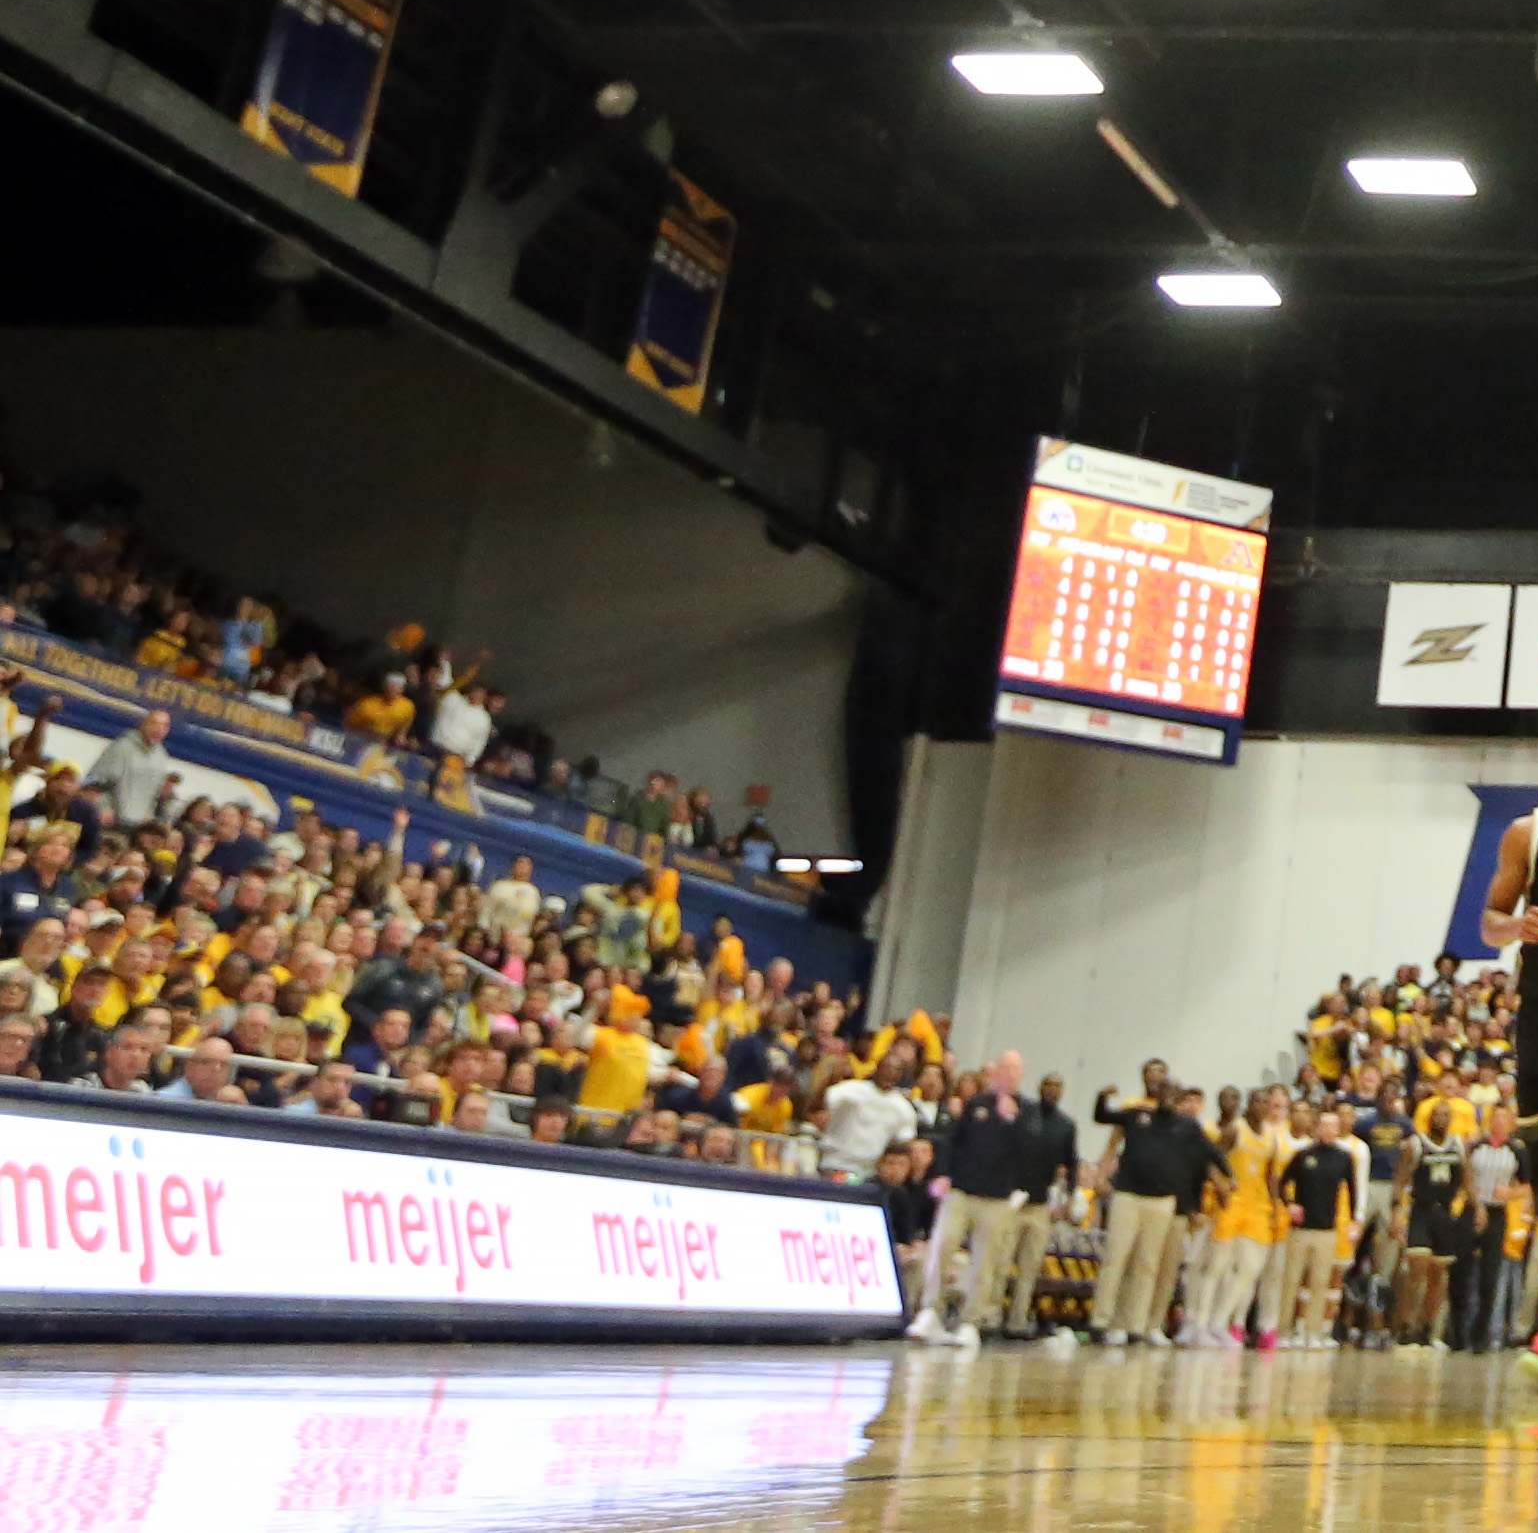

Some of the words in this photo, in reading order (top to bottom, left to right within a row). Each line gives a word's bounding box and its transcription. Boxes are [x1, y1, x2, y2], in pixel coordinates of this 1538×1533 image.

[342, 1167, 514, 1294] meijer
[592, 1191, 723, 1301] meijer
[780, 1209, 883, 1305] meijer
